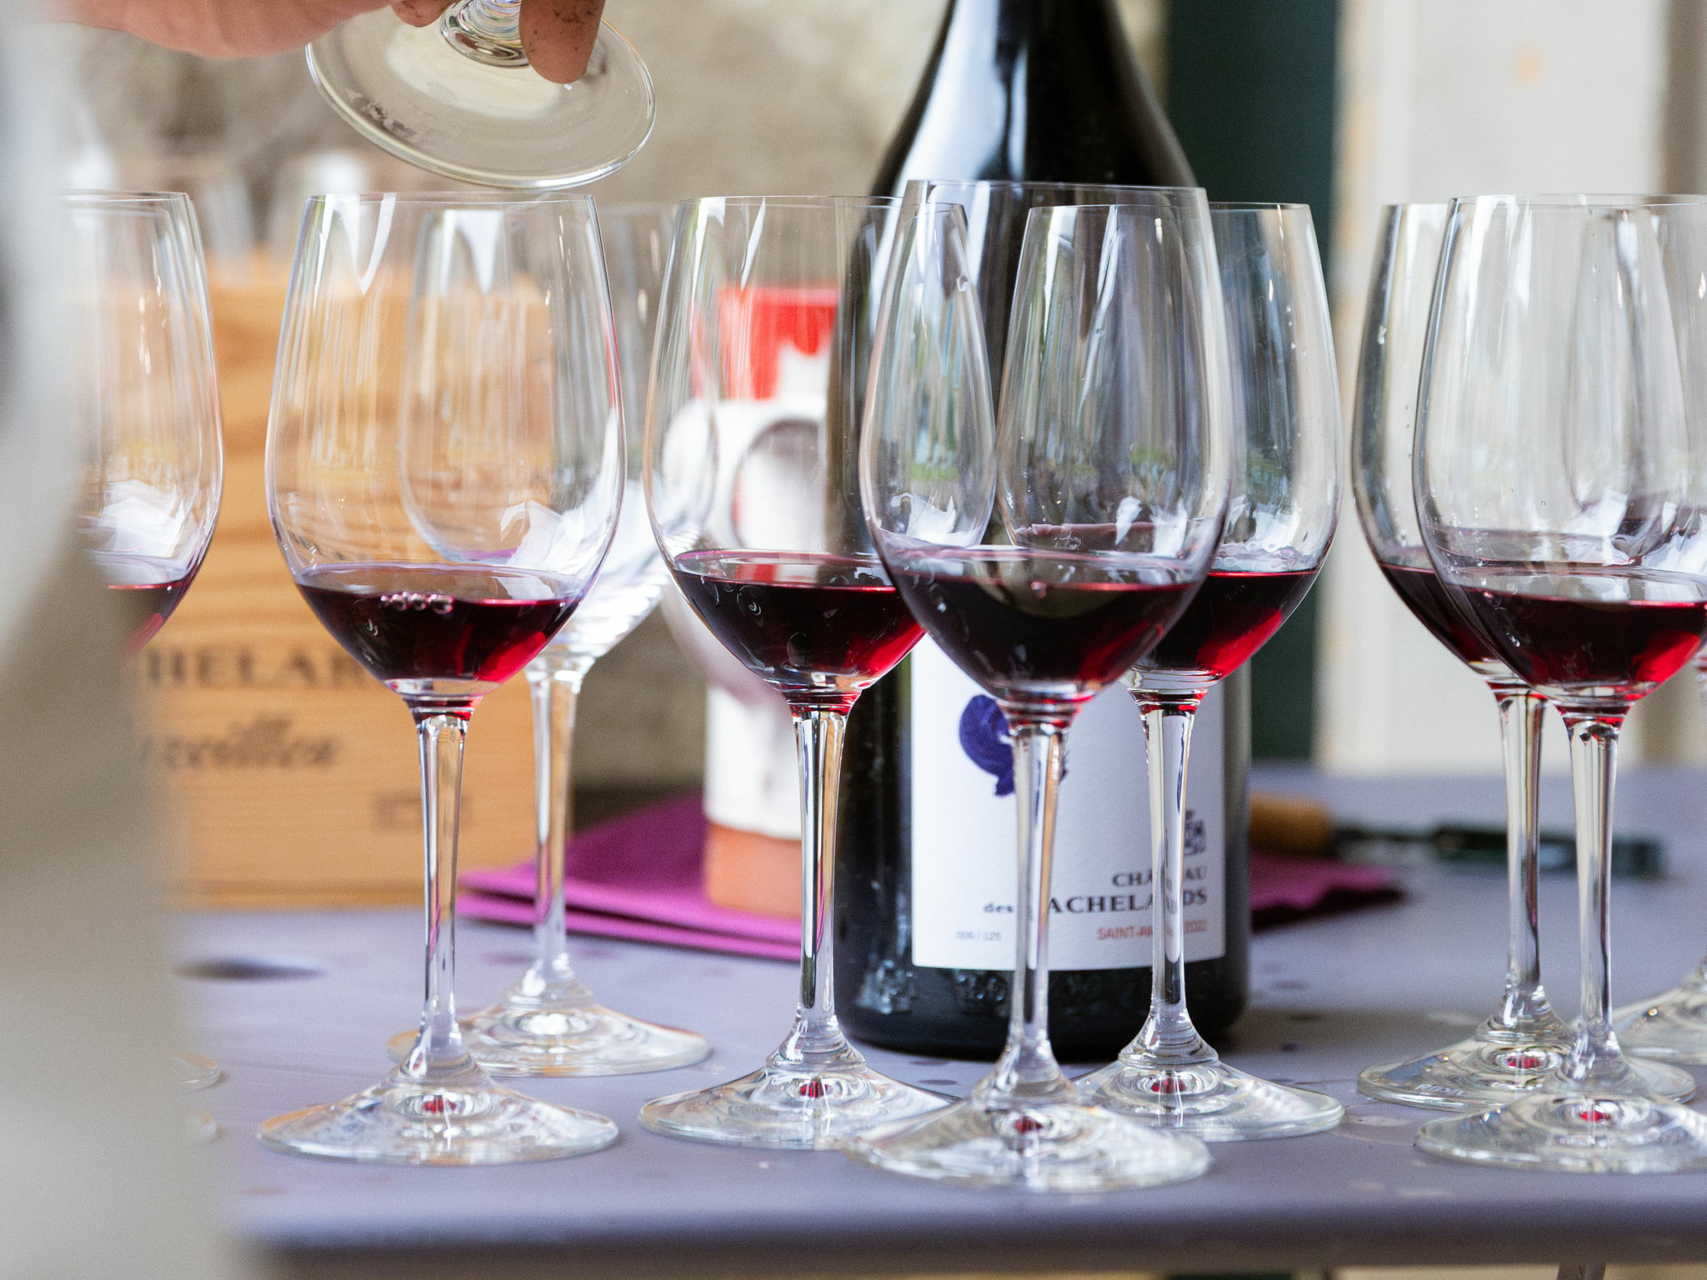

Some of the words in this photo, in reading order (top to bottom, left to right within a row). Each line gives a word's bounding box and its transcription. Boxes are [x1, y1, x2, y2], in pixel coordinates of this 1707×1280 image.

[1111, 866, 1207, 887] CHAU
[983, 901, 1014, 914] des
[1048, 886, 1207, 915] ACHELDS
